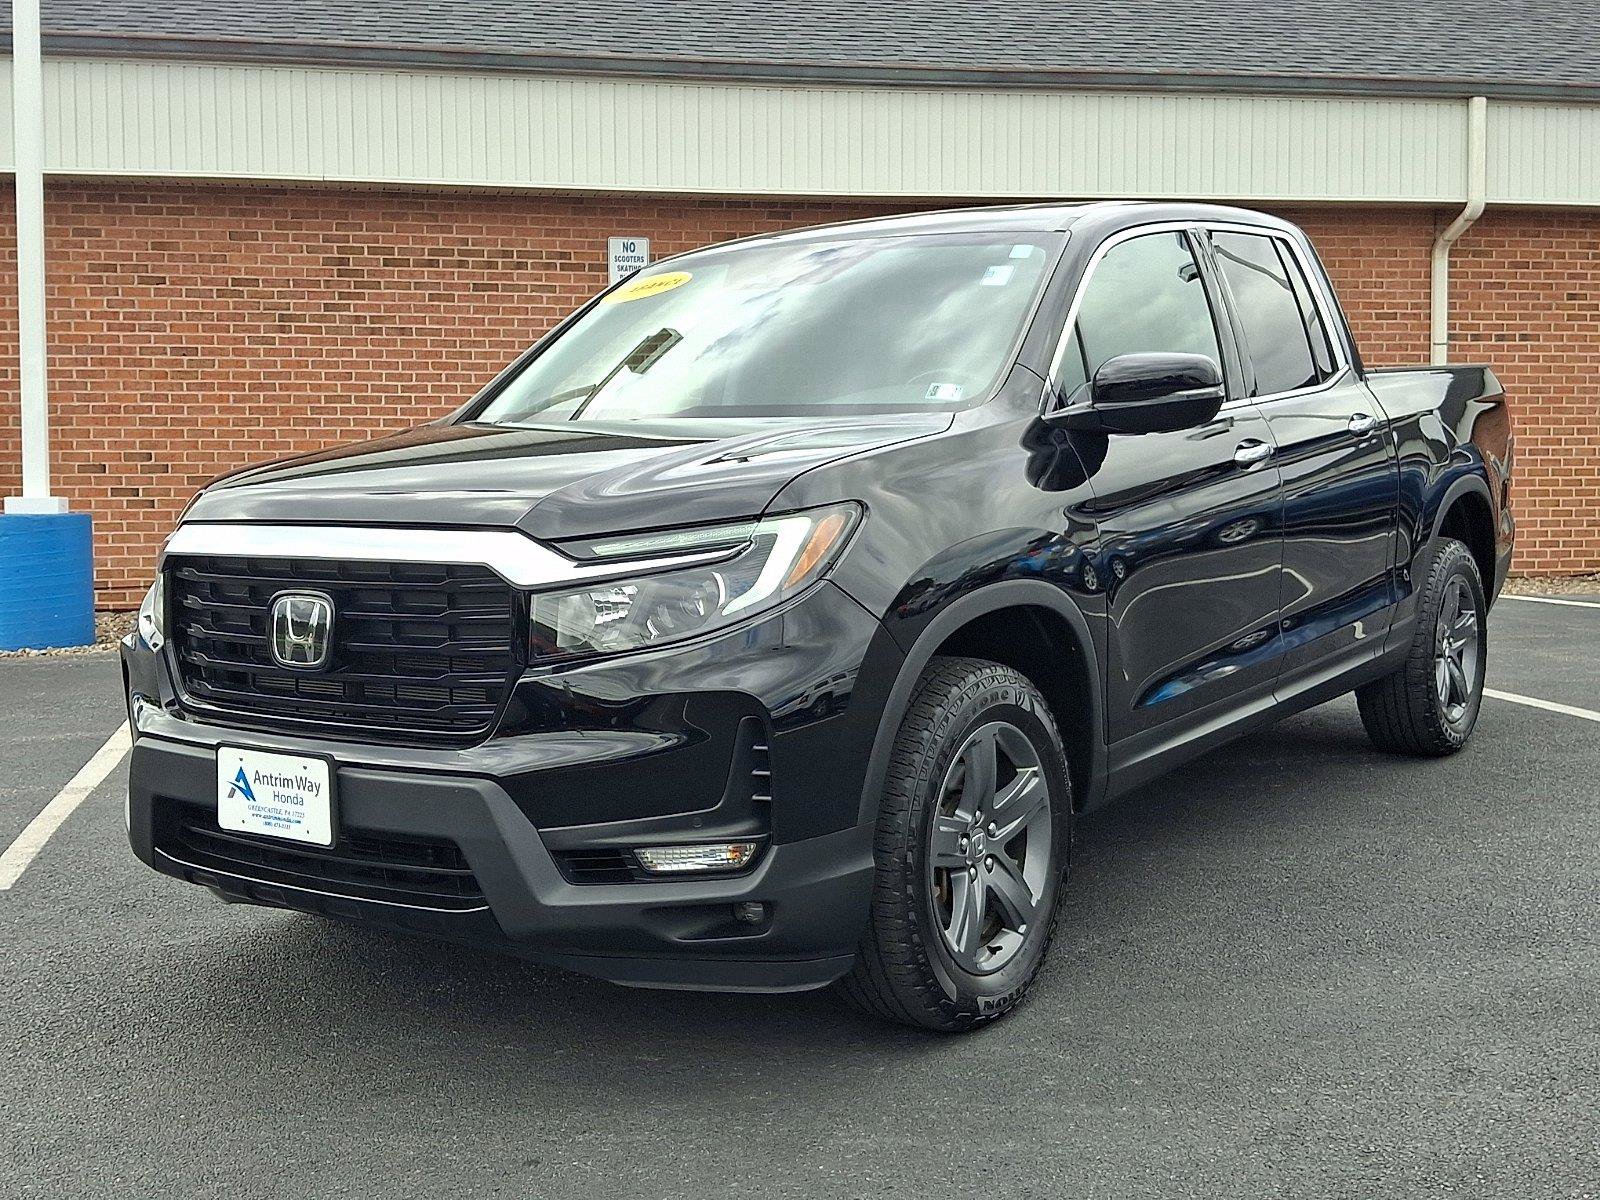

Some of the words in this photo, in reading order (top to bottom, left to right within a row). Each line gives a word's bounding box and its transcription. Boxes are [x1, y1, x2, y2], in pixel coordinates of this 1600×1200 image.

[622, 241, 636, 253] NO
[614, 255, 645, 263] SCOOTERS
[253, 769, 294, 790] Antrim
[295, 775, 321, 797] Way
[273, 790, 304, 806] Honda
